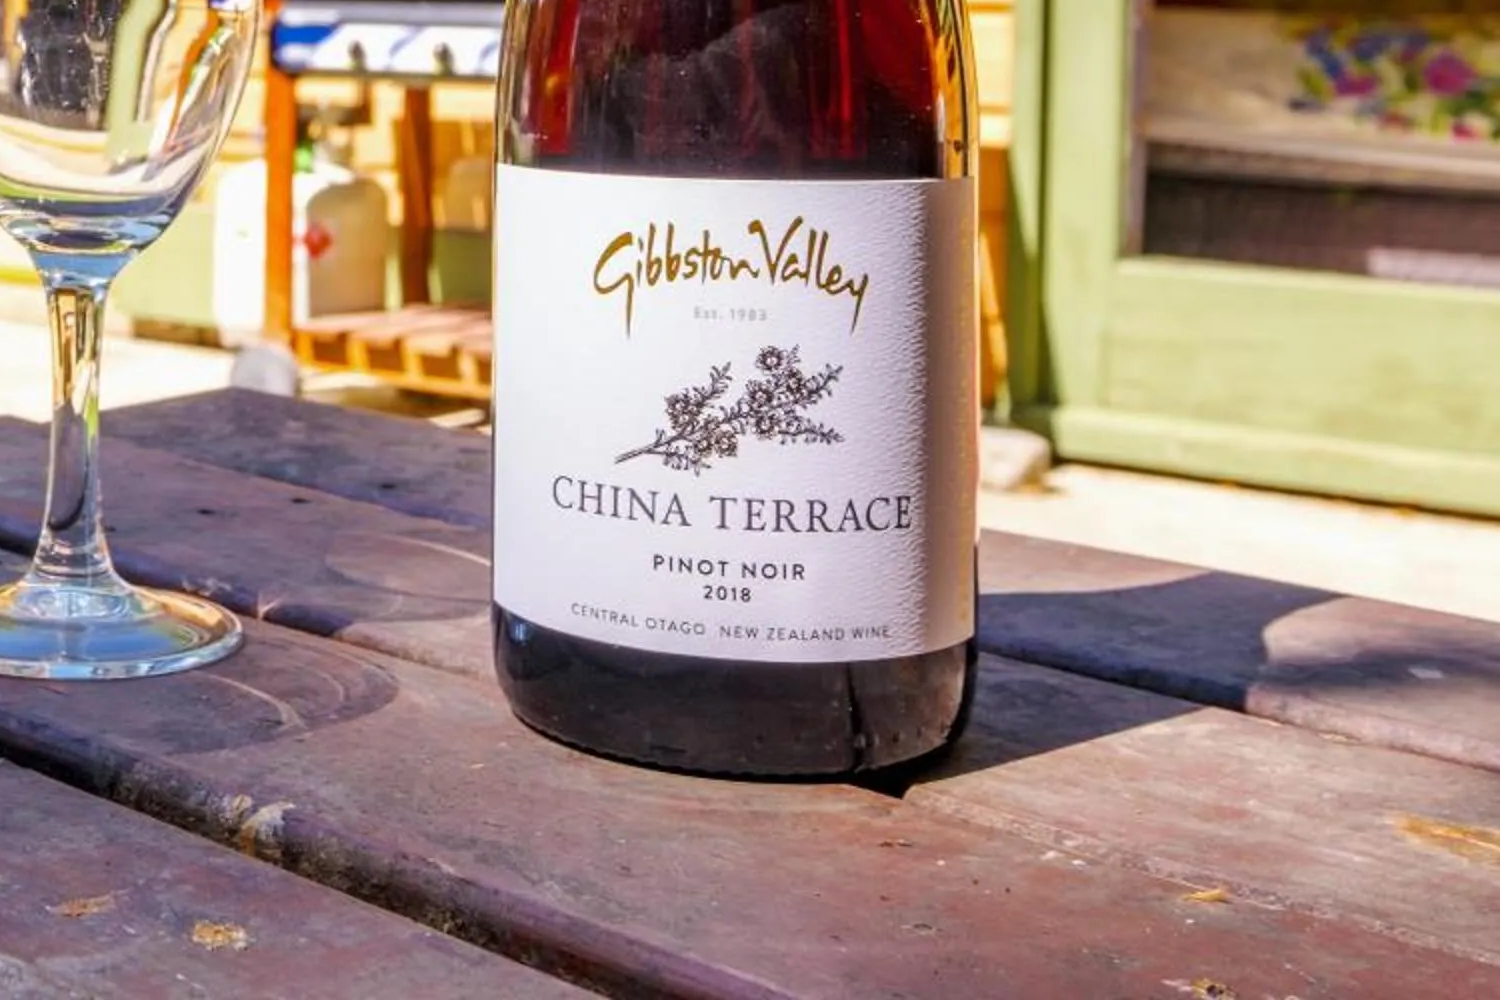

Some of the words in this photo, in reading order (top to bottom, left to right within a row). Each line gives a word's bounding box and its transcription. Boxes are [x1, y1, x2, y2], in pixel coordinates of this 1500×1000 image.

[593, 222, 760, 340] Gibbston
[748, 215, 869, 337] Valley
[552, 475, 692, 527] CHINA
[708, 496, 912, 533] TERRACE
[652, 554, 730, 577] PINOT
[741, 562, 806, 581] NOIR
[703, 585, 752, 603] 2018
[571, 602, 639, 628] CENTRAL
[645, 617, 706, 636] OTAGO
[720, 625, 758, 640] NEW
[766, 626, 845, 642] ZEALAND
[852, 625, 891, 640] WINE
